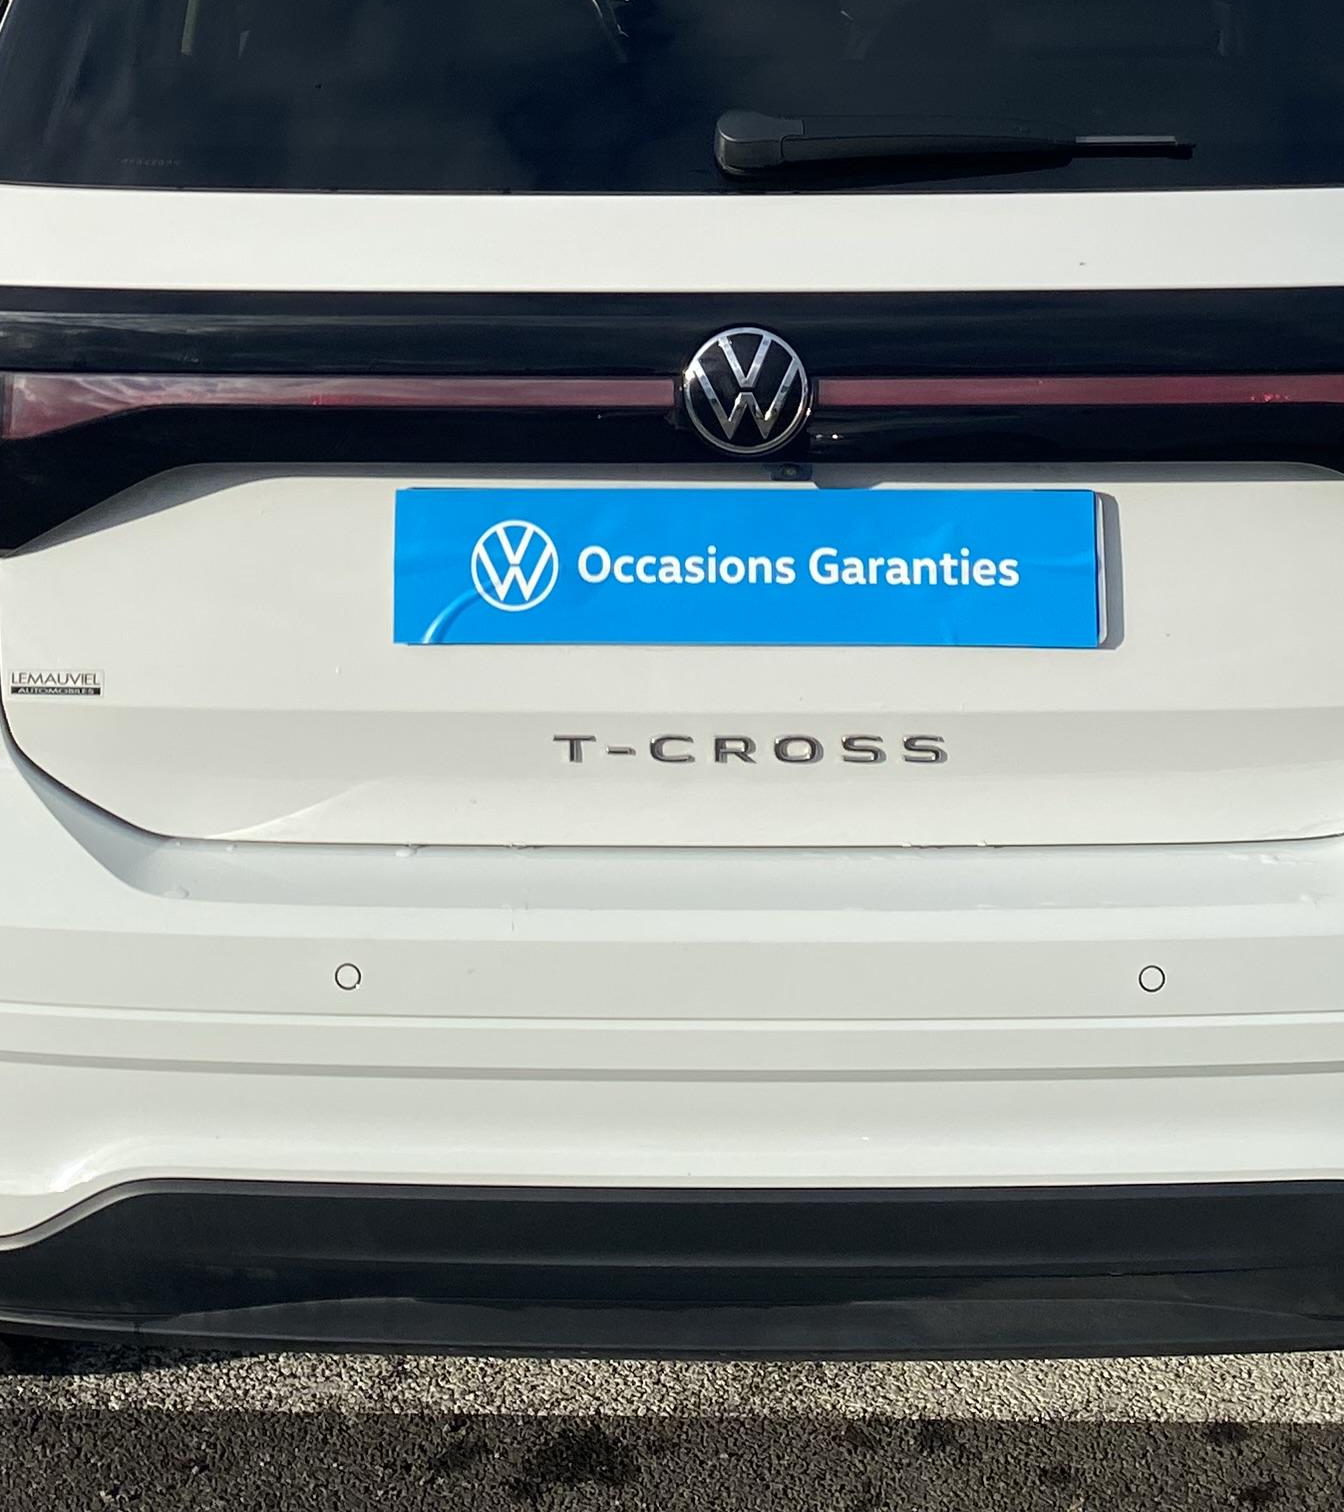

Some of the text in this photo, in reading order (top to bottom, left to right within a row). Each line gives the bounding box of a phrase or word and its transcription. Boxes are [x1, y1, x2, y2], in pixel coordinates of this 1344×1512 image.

[577, 545, 1020, 587] Occasions Garanties
[11, 672, 101, 686] LEMAUVIEL
[553, 734, 948, 765] T-CROSS
